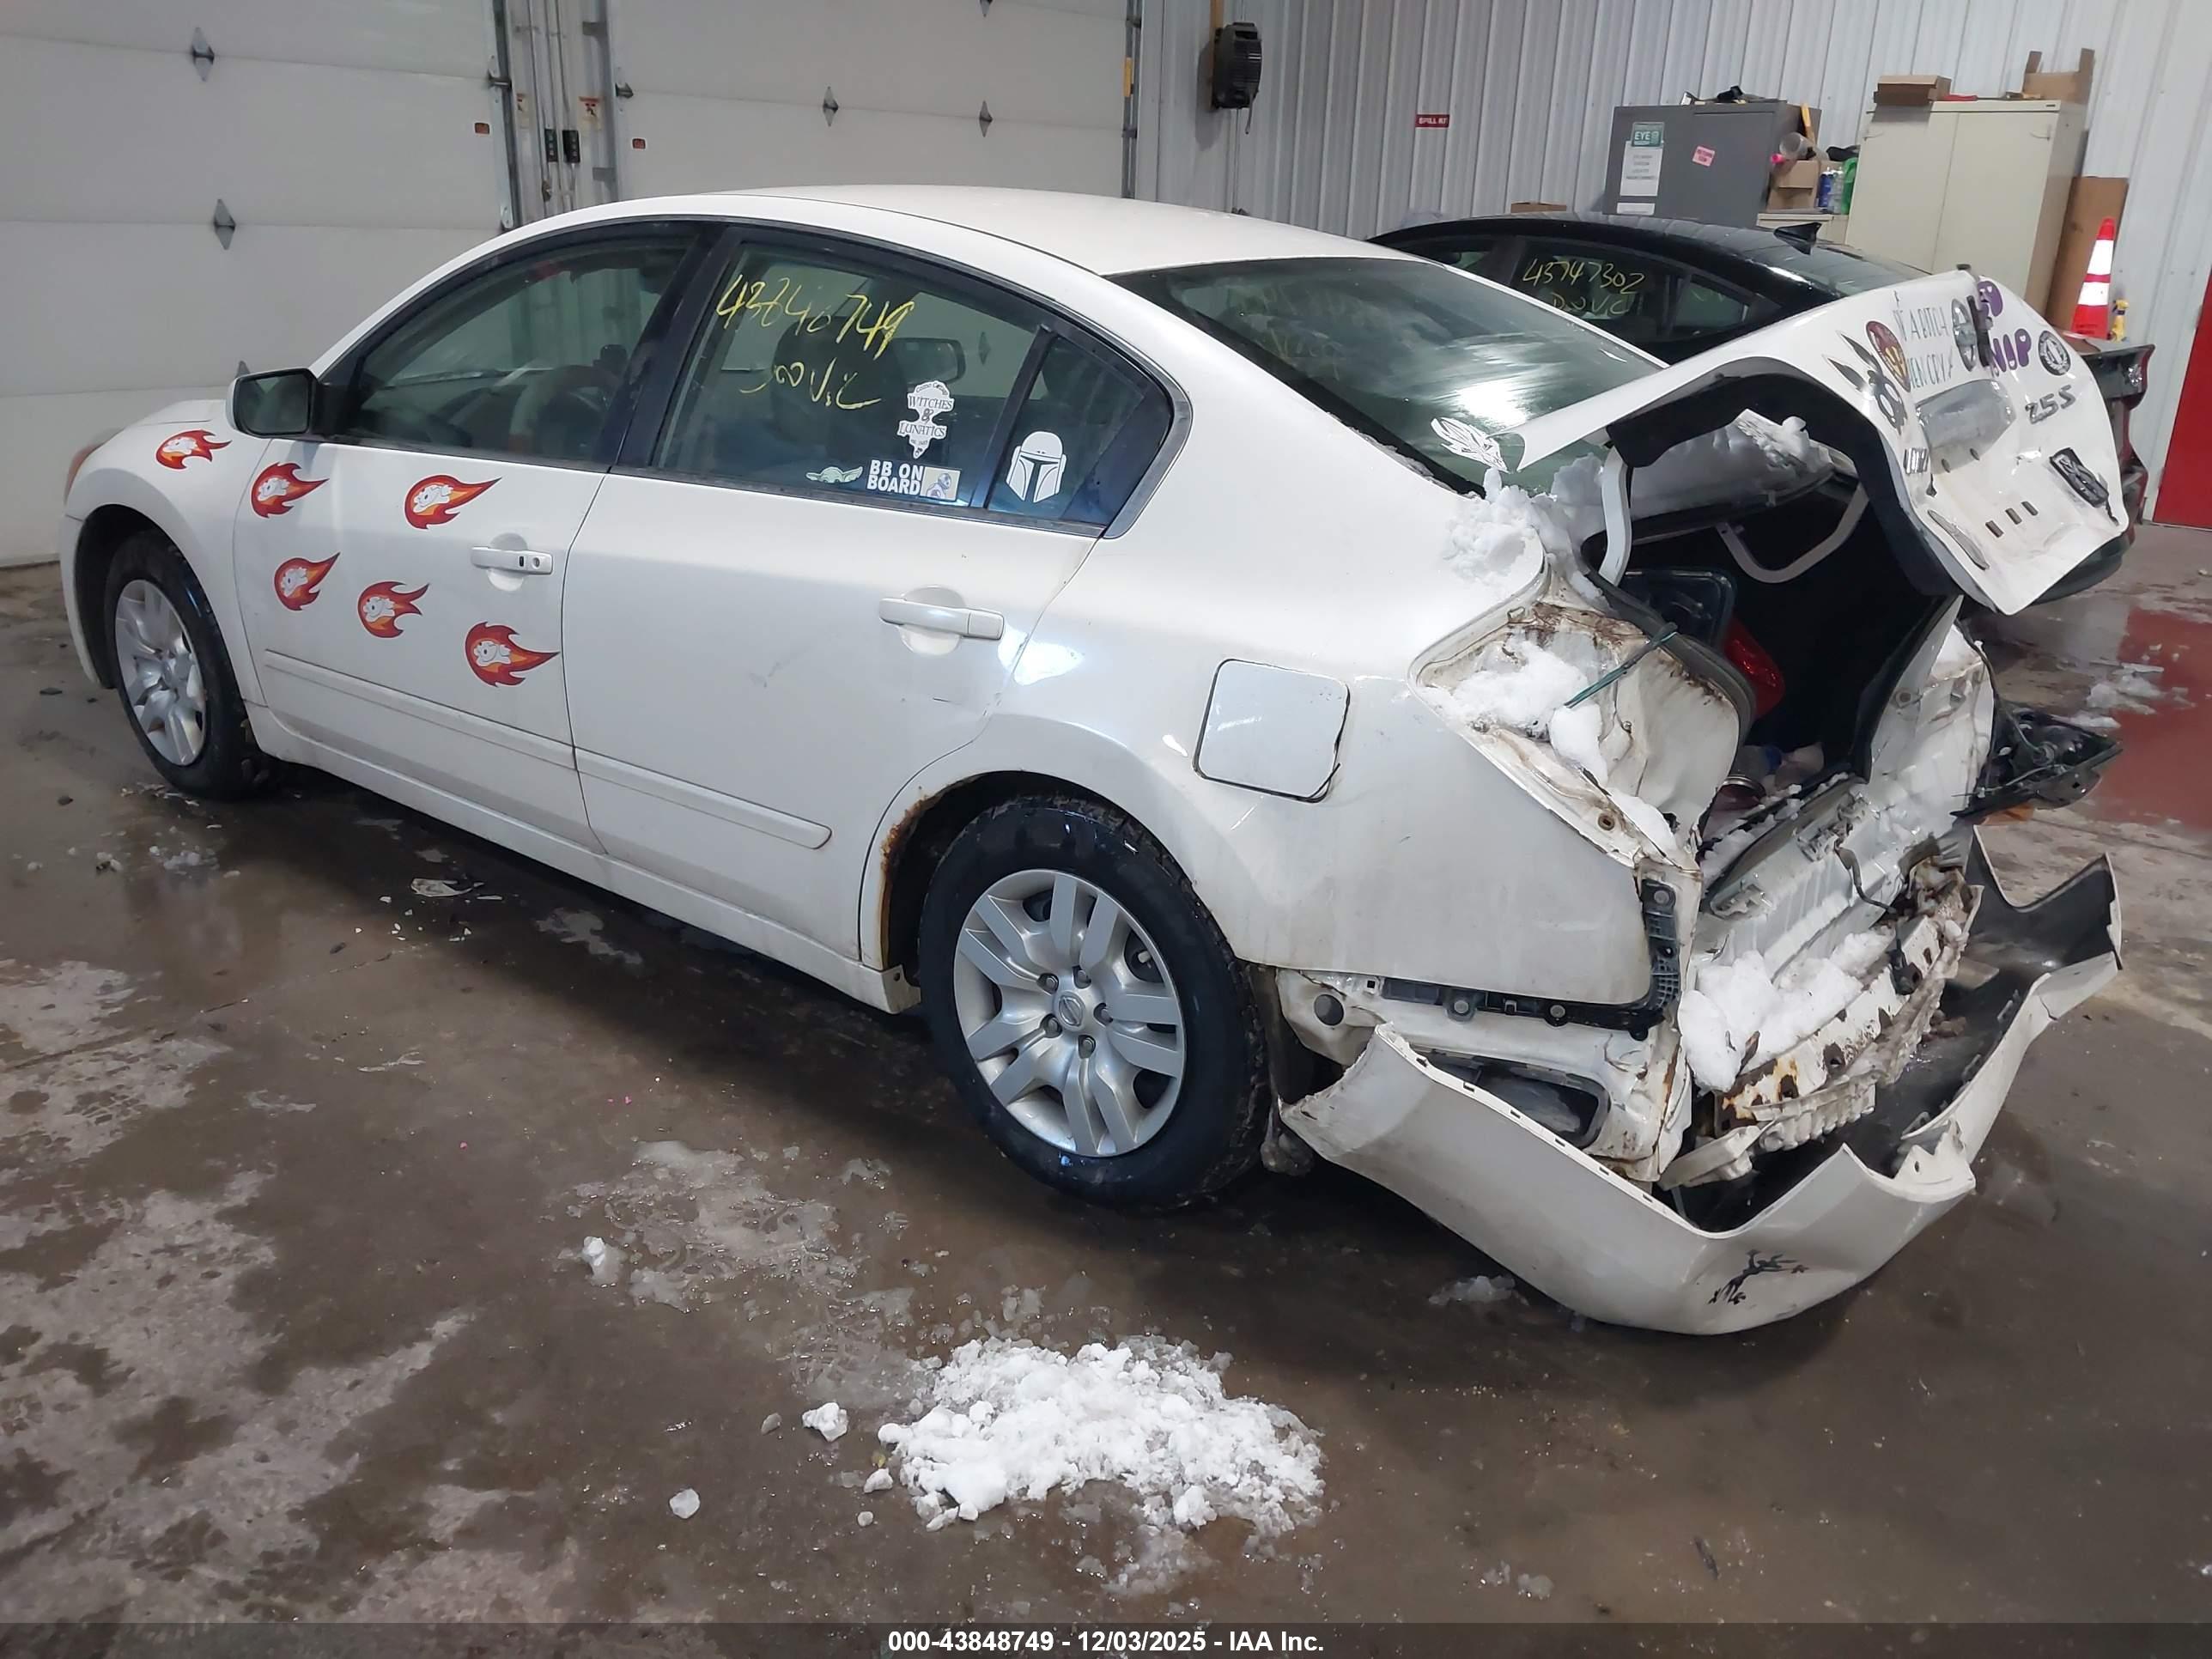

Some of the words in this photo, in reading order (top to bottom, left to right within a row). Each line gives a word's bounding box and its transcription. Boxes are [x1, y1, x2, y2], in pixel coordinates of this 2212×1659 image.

[1634, 131, 1650, 140] EYE
[908, 395, 952, 410] WITCHES
[899, 422, 945, 437] LUNATICS
[870, 459, 893, 477] BB
[898, 463, 924, 482] ON
[866, 474, 921, 495] BOARD
